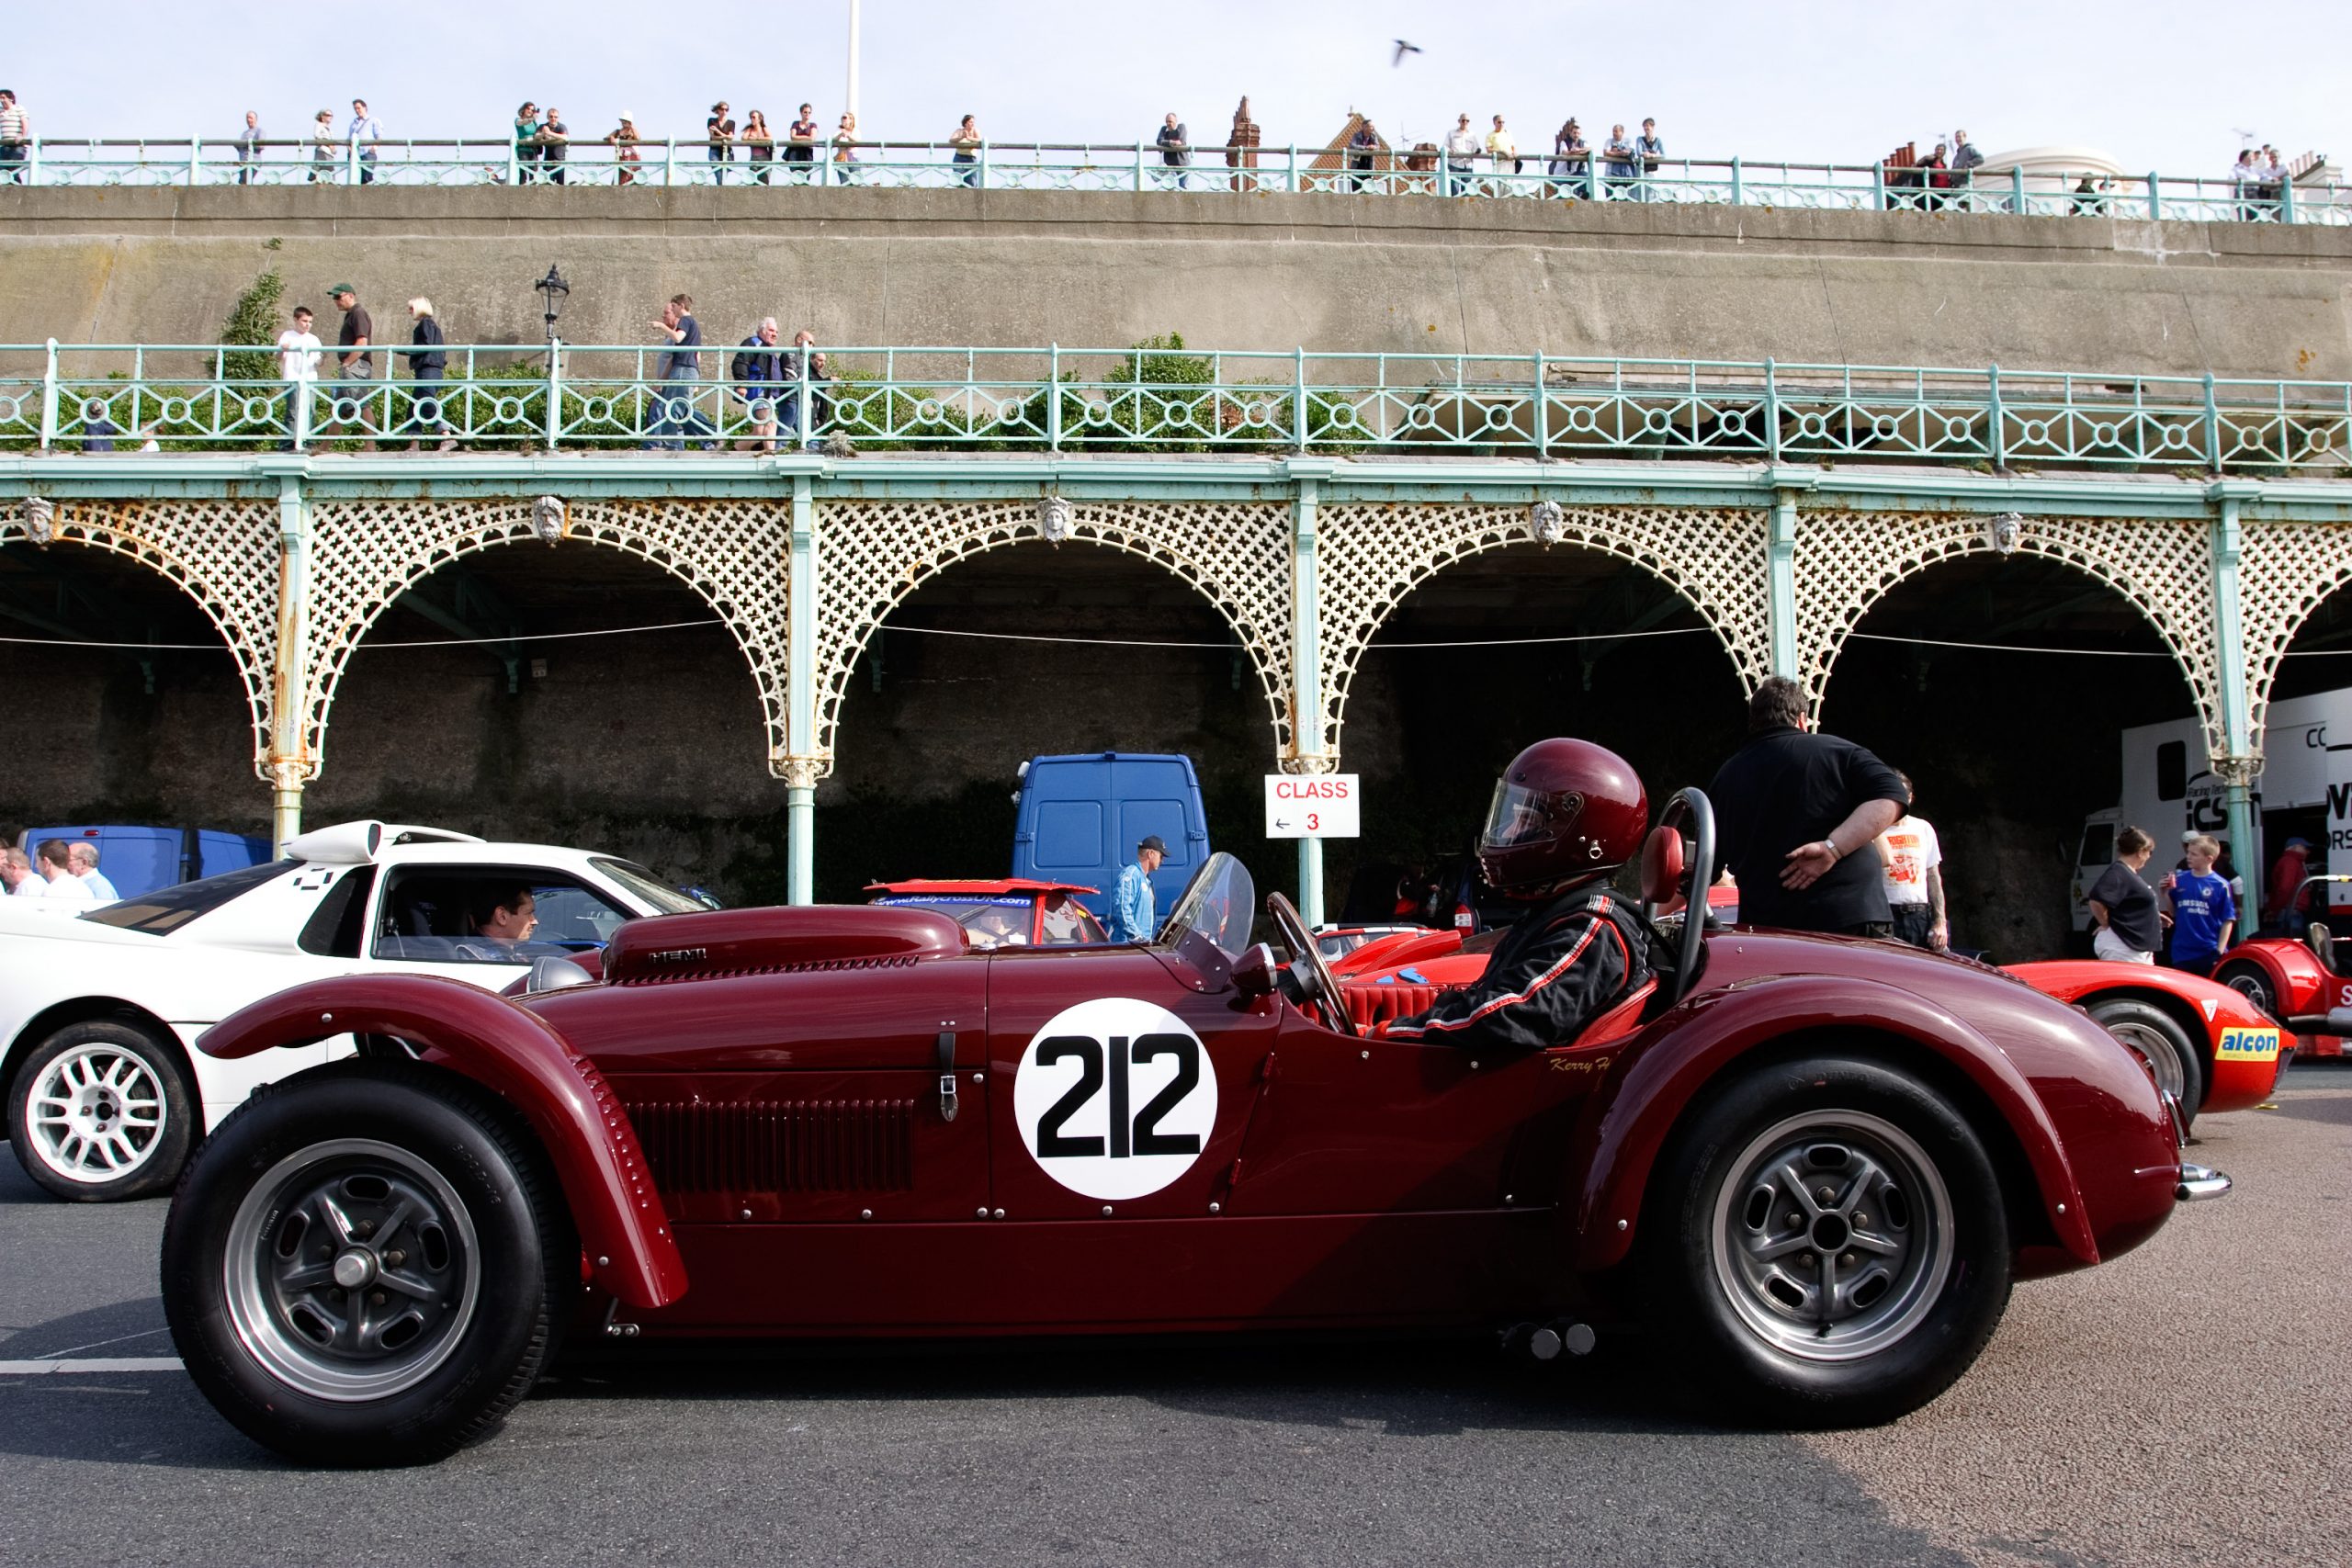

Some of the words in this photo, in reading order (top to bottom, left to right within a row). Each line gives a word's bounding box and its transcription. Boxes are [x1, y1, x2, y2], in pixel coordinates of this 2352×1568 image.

[1276, 782, 1349, 799] CLASS
[1307, 813, 1319, 830] 3
[648, 948, 707, 964] HEMI
[2222, 1032, 2278, 1052] alcon
[1550, 1058, 1593, 1074] Kerry
[1035, 1033, 1201, 1158] 212
